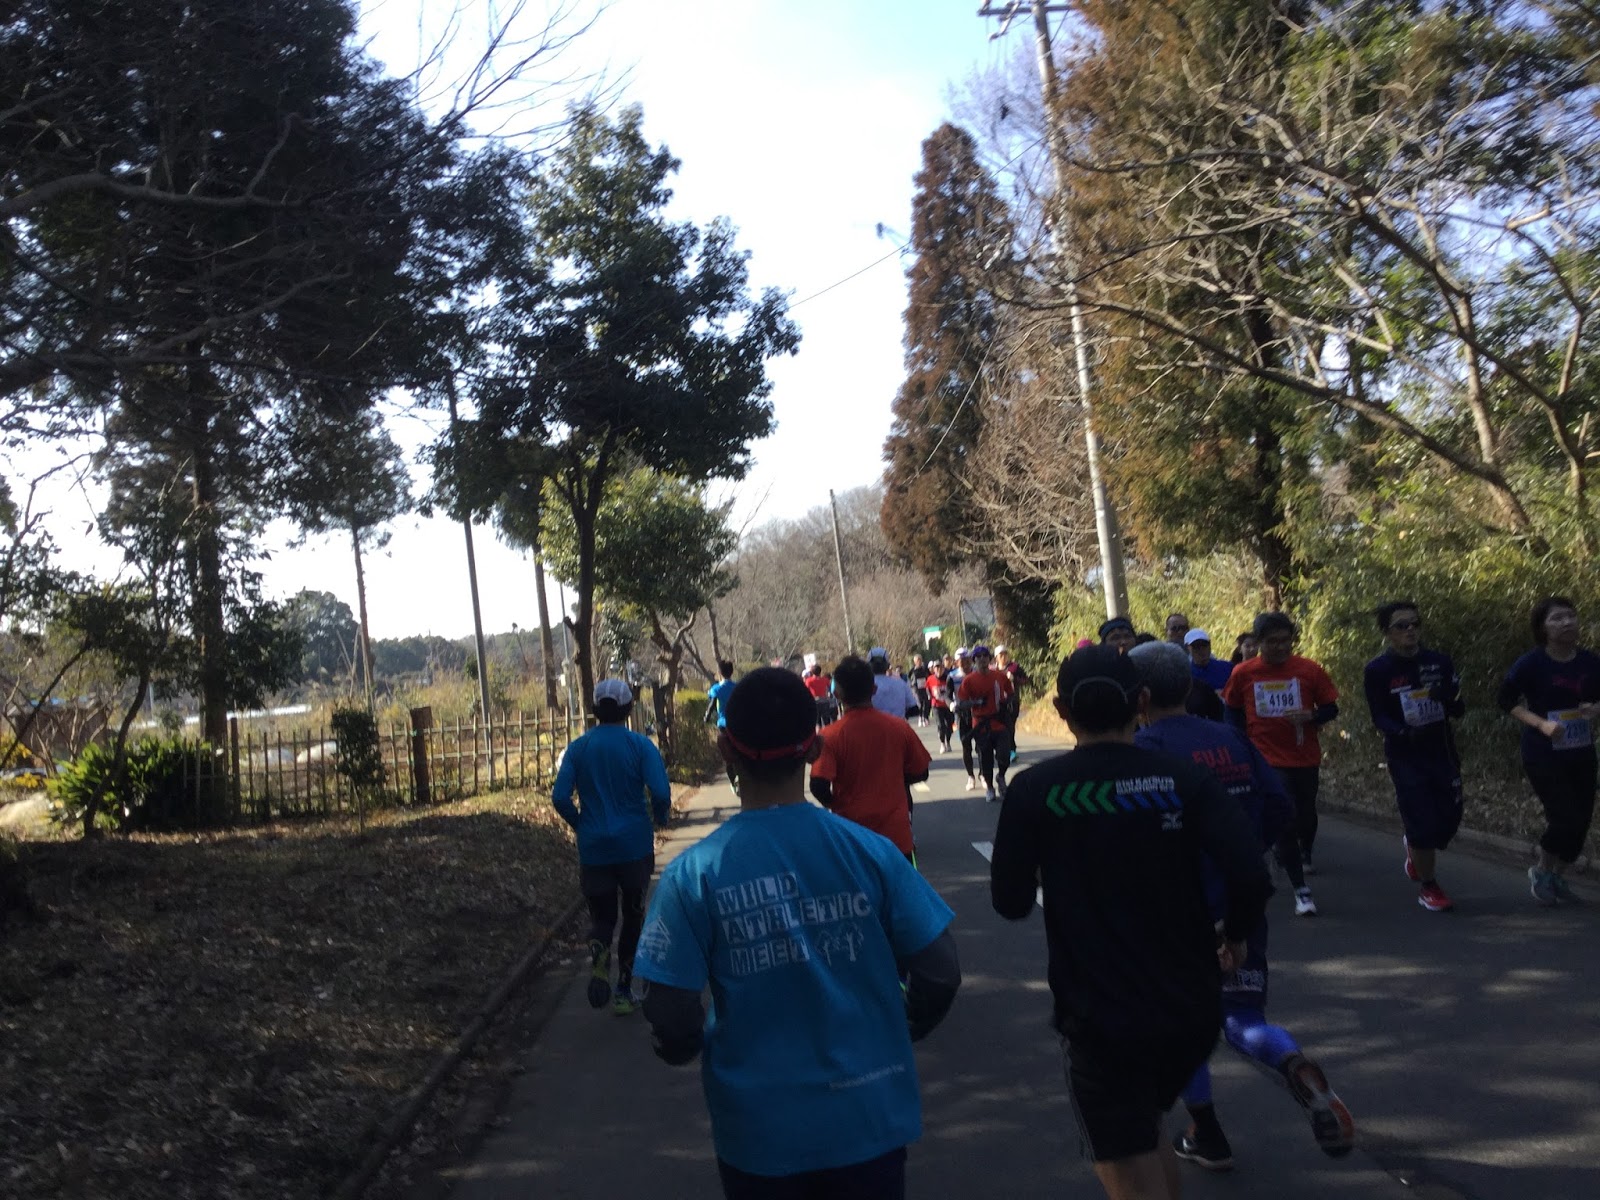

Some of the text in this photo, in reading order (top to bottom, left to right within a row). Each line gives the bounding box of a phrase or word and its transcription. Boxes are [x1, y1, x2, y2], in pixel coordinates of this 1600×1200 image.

[1269, 692, 1294, 708] 4198
[1192, 746, 1232, 769] FUJI
[715, 872, 799, 916] WILD
[721, 892, 872, 945] ATHLETIC
[730, 934, 810, 977] MEET
